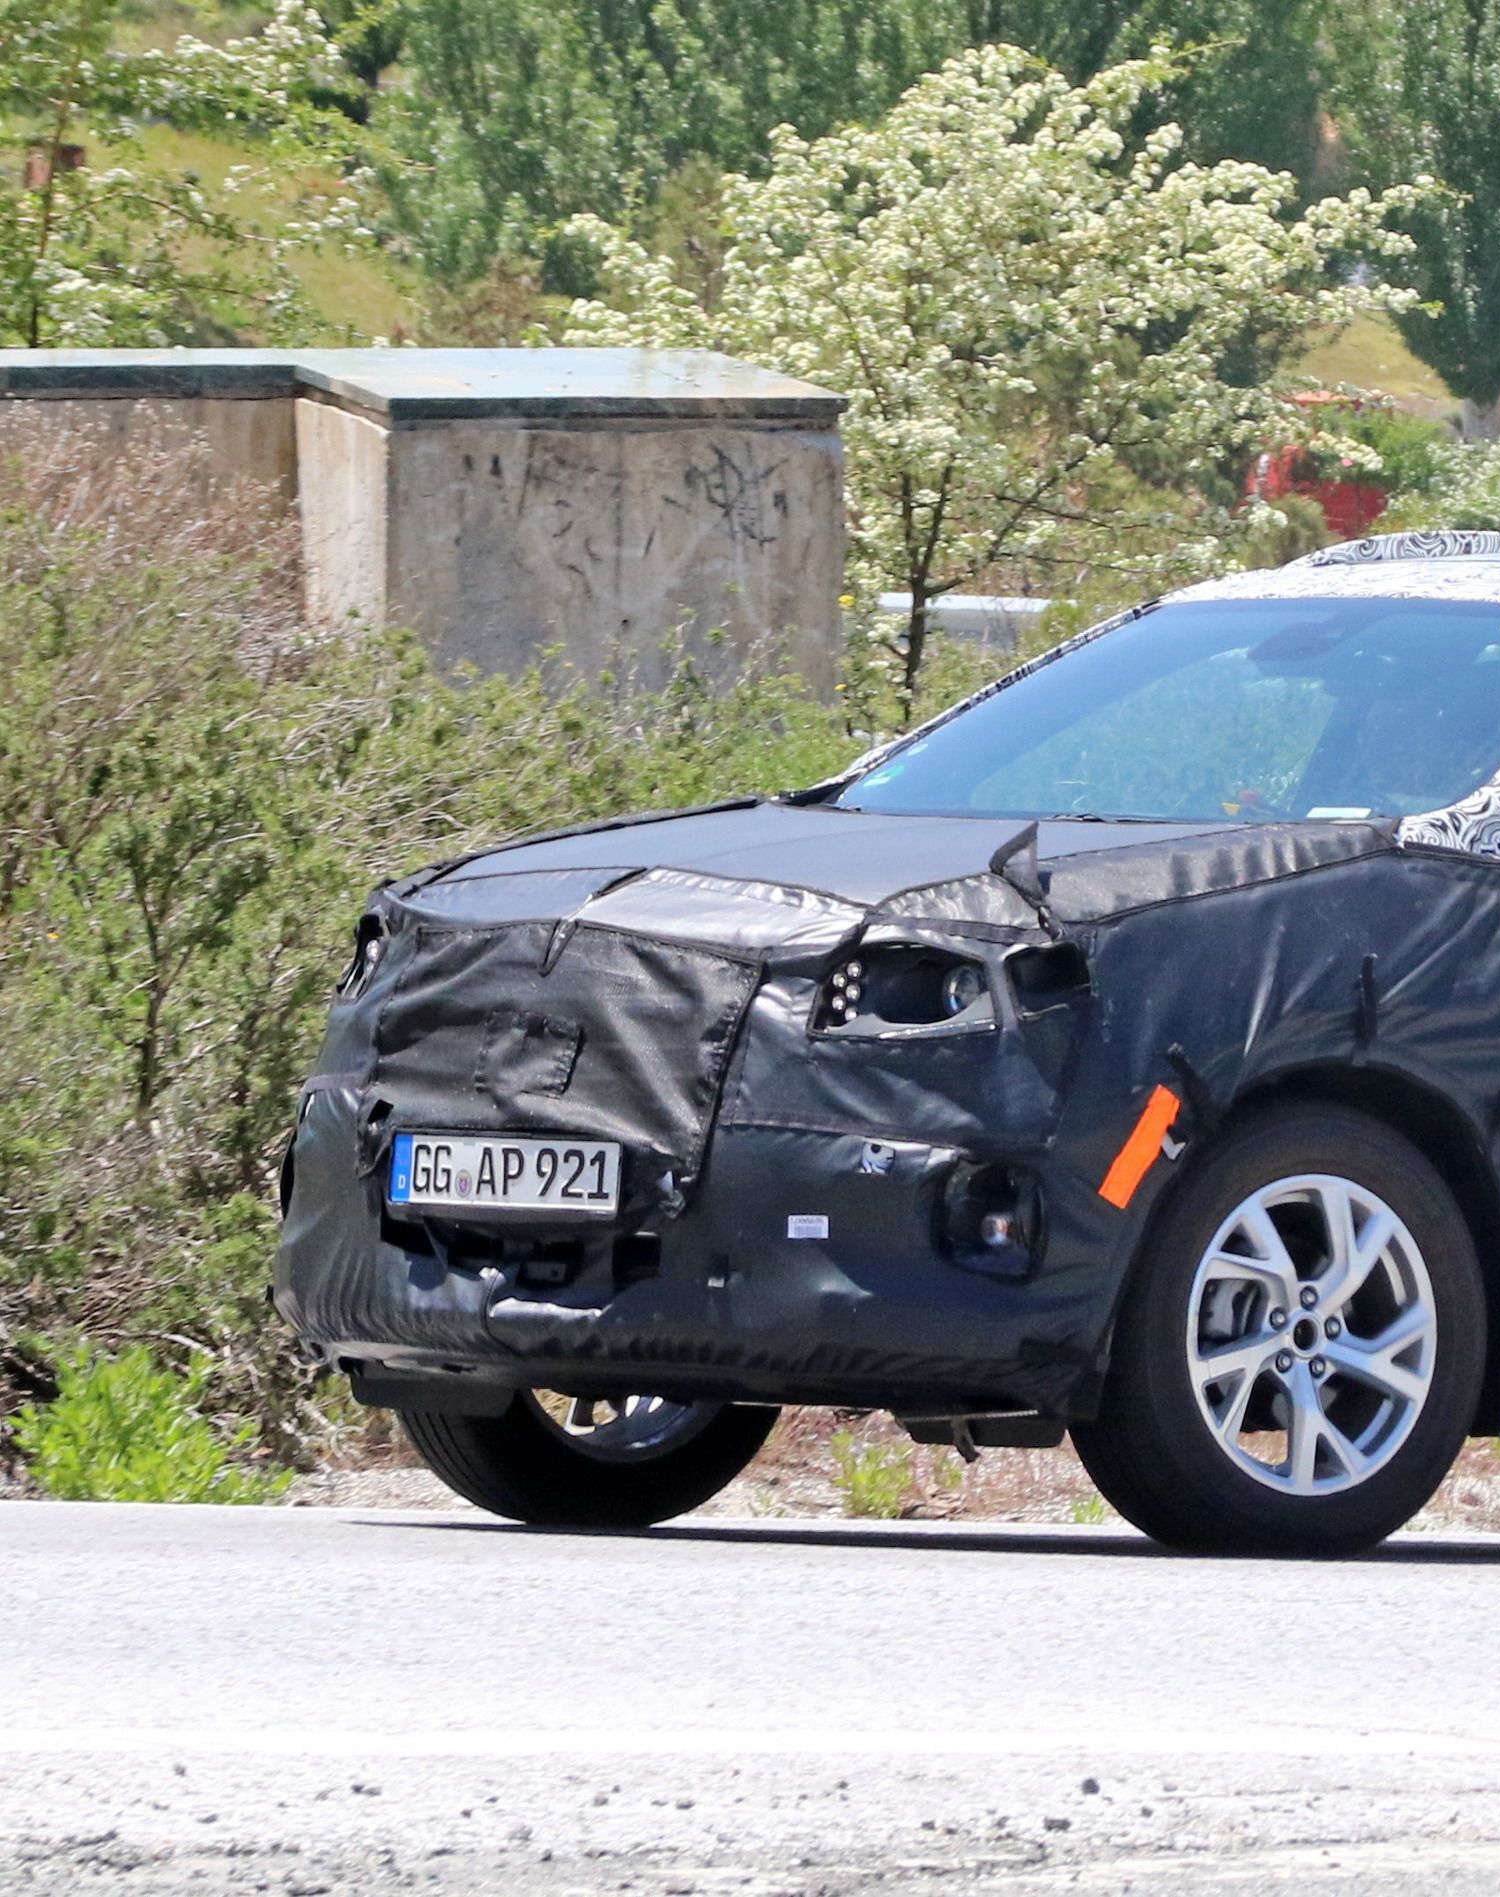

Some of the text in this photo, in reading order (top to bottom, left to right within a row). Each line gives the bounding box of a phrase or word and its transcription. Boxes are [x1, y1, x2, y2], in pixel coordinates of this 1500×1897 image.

[397, 1175, 406, 1189] D
[413, 1144, 610, 1200] GG AP 921
